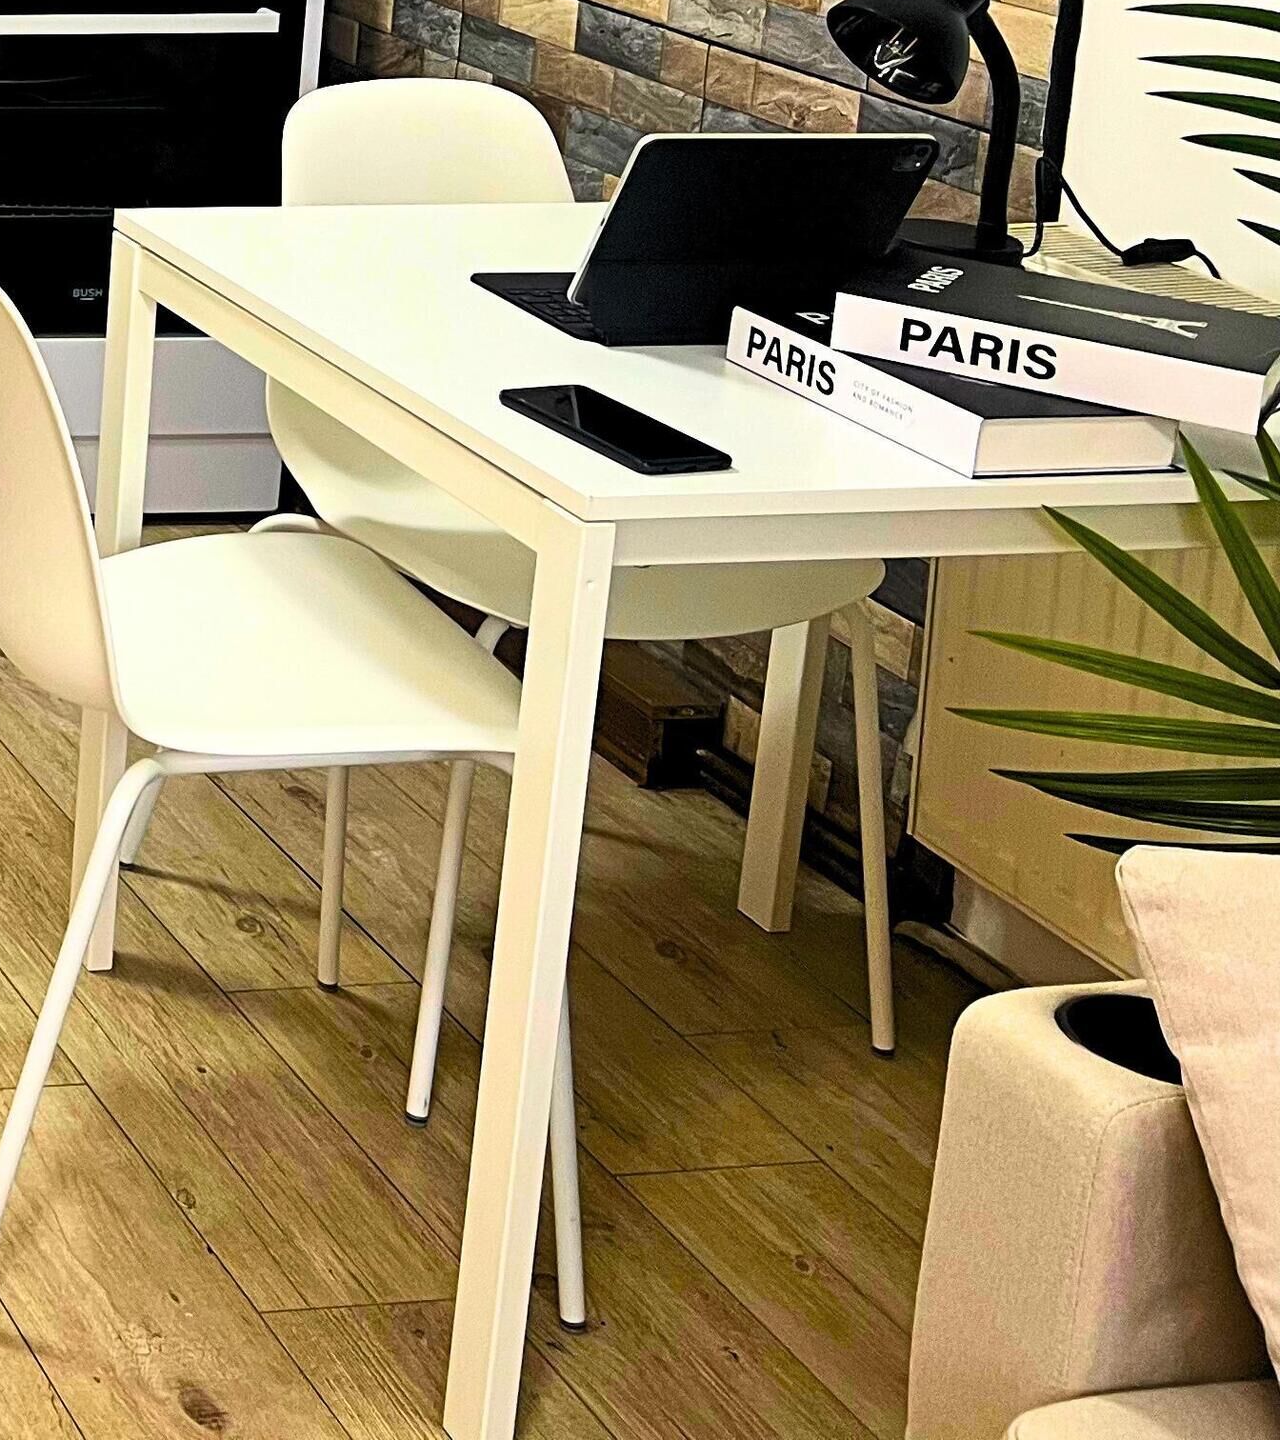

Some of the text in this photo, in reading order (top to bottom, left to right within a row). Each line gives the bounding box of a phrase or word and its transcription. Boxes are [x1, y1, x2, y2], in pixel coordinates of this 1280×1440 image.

[73, 288, 103, 297] BUSH
[907, 266, 964, 293] PARIS
[746, 326, 836, 396] PARIS
[899, 317, 1057, 380] PARIS
